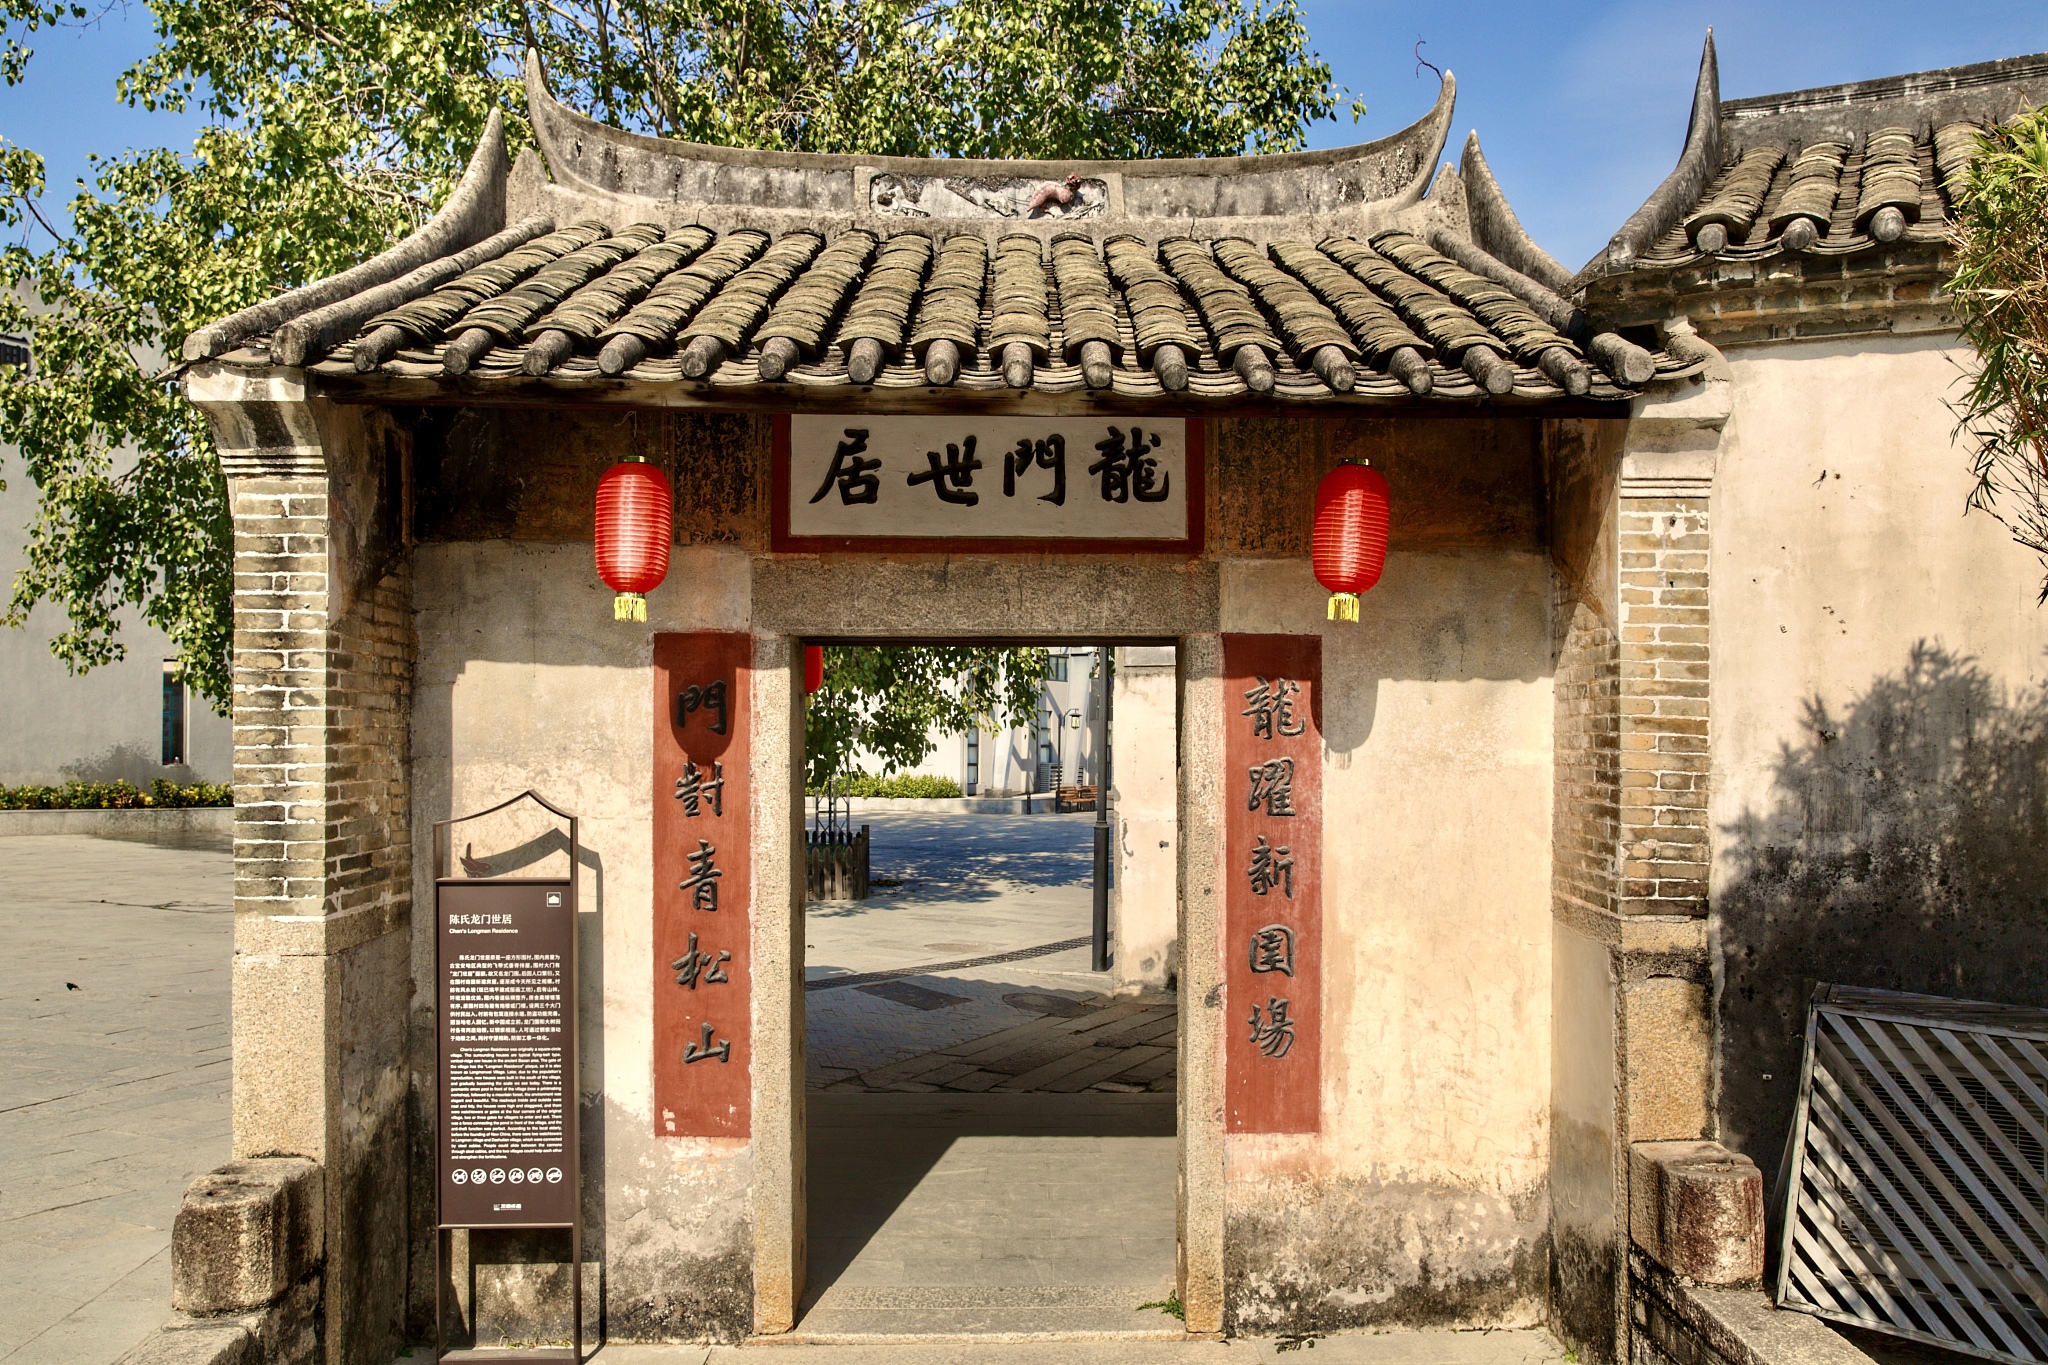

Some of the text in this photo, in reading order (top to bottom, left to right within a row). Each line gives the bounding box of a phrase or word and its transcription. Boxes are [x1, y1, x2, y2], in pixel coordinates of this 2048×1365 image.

[449, 914, 512, 925] 陈氏龙门世居
